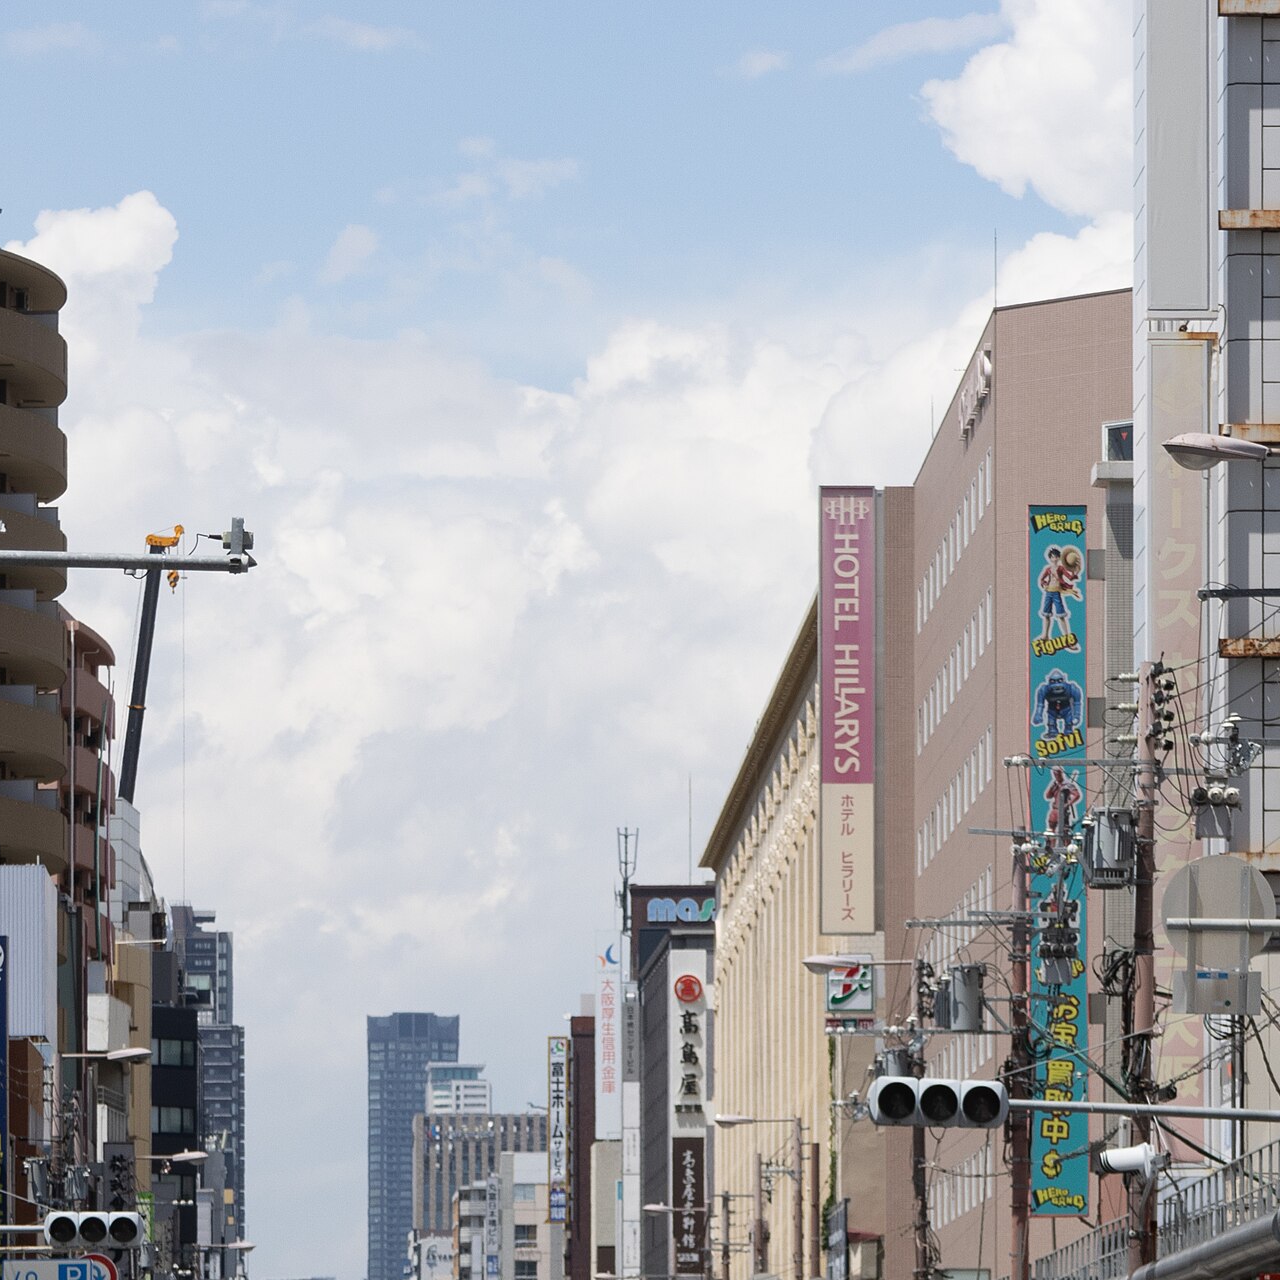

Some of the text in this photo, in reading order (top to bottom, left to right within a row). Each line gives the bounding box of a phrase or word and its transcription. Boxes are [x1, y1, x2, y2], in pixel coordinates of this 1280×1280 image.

[833, 533, 865, 774] HOTEL HILLARYS
[1032, 633, 1077, 657] Figure
[1035, 729, 1082, 759] Sofvi
[839, 794, 856, 921] ホテル ヒラリーズ
[601, 978, 616, 1094] 大阪厚生信用金庫
